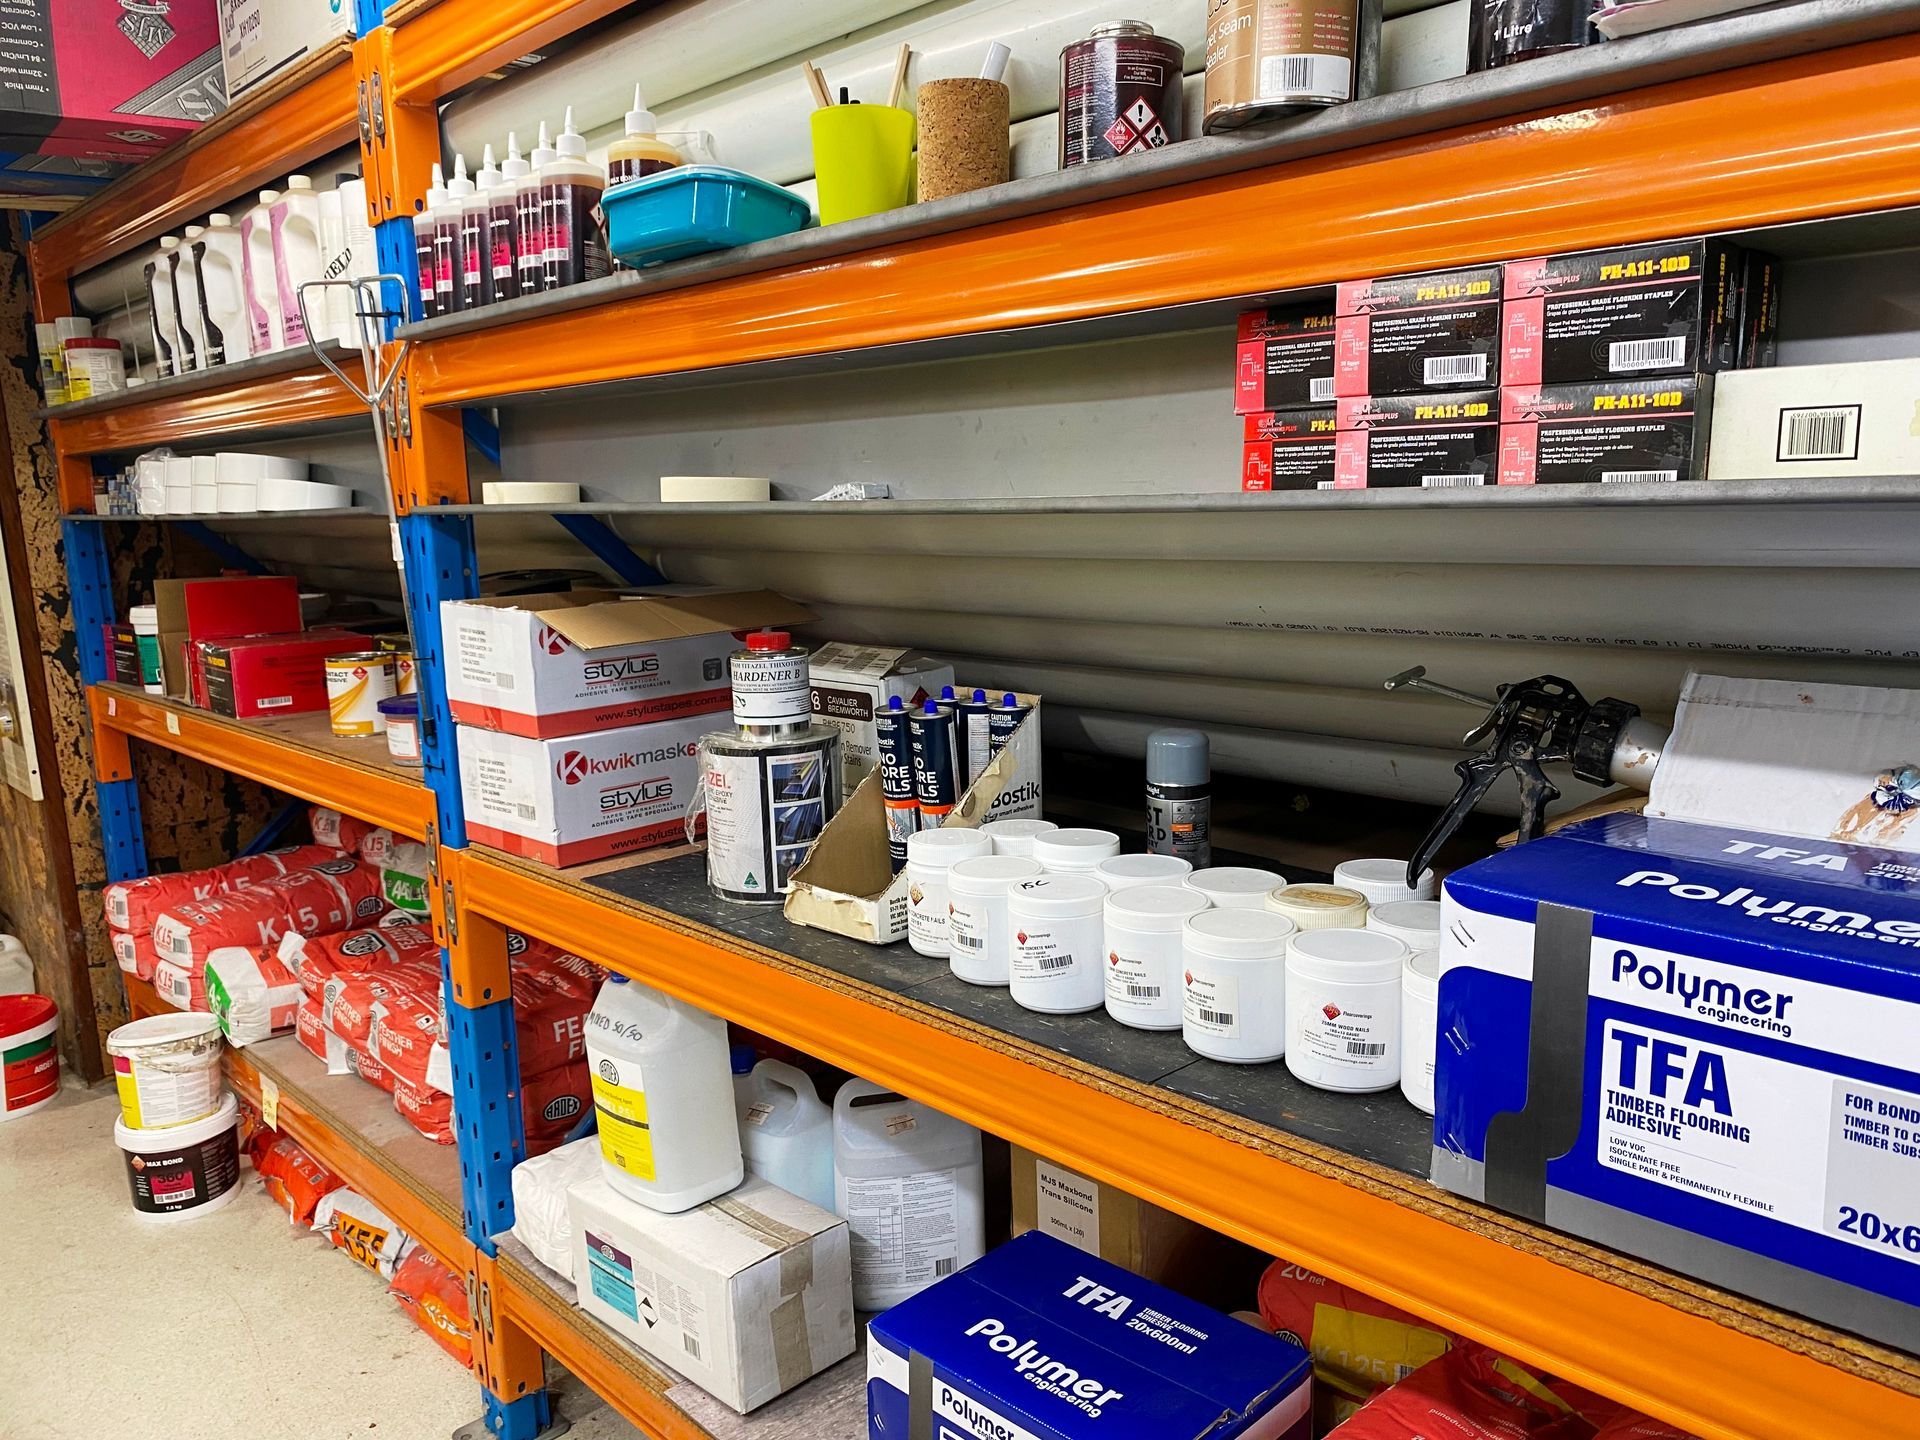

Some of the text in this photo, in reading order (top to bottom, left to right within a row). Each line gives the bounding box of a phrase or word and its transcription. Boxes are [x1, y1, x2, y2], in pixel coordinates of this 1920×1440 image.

[1, 21, 37, 33] Low VOC
[1219, 14, 1252, 39] Seam
[1503, 23, 1534, 40] Litre
[18, 68, 42, 78] 32mm
[4, 81, 45, 93] 7mm thick
[1600, 255, 1691, 281] PH-A11-10D
[1416, 280, 1491, 301] PH-A11-10D
[1547, 299, 1591, 311] PROFESSIONAL
[1644, 290, 1674, 300] STAPLES
[1621, 359, 1671, 369] 00000 11100
[1414, 403, 1489, 420] PH-A11-10D
[1593, 391, 1683, 411] PH-A11-10D
[1709, 642, 1751, 651] PHONE
[1864, 648, 1892, 657] PVC
[584, 654, 660, 681] stylus
[732, 668, 800, 682] HARDENER B
[574, 680, 671, 699] ADHESIVE TAPE SPECIALISTS
[827, 695, 858, 708] CAVALIER
[827, 704, 869, 718] BREMWORTH
[600, 779, 673, 810] stylus
[591, 803, 685, 829] ADHESIVE TAPE SPECIALISTS
[1721, 839, 1849, 872] TFA
[156, 924, 174, 947] K15
[157, 967, 173, 990] K15
[1611, 949, 1794, 1020] Polymer
[334, 1009, 353, 1031] FINISH
[336, 994, 362, 1026] FEATHER
[1697, 1003, 1793, 1038] engineering
[379, 1021, 413, 1050] FEATHER
[611, 1020, 643, 1042] 50/50
[379, 1034, 403, 1057] FINISH
[1611, 1027, 1733, 1117] TFA
[1845, 1092, 1874, 1114] FOR
[1605, 1107, 1682, 1141] ADHESIVE
[1606, 1089, 1751, 1144] TIMBER FLOORING
[1844, 1114, 1910, 1141] TIMBER TO
[1609, 1136, 1646, 1154] LOW VOC
[1843, 1128, 1889, 1151] TIMBER
[146, 1157, 184, 1168] MAX BOND
[1609, 1146, 1681, 1174] ISOCYANATE FREE
[1041, 1174, 1093, 1202] MJS Maxbond
[1609, 1155, 1775, 1214] SINGLE PART & PERMANENTLY FLEXIBLE
[1040, 1185, 1094, 1215] Trans Silicone
[1309, 1273, 1326, 1288] net
[1062, 1276, 1134, 1321] TFA
[1135, 1311, 1174, 1333] ADHESIVE
[1141, 1306, 1209, 1342] TIMBER FLOORING
[1125, 1316, 1198, 1356] 20x600ml
[964, 1317, 1124, 1405] Polymer
[1023, 1371, 1103, 1418] engineering
[941, 1387, 1015, 1440] Polymer
